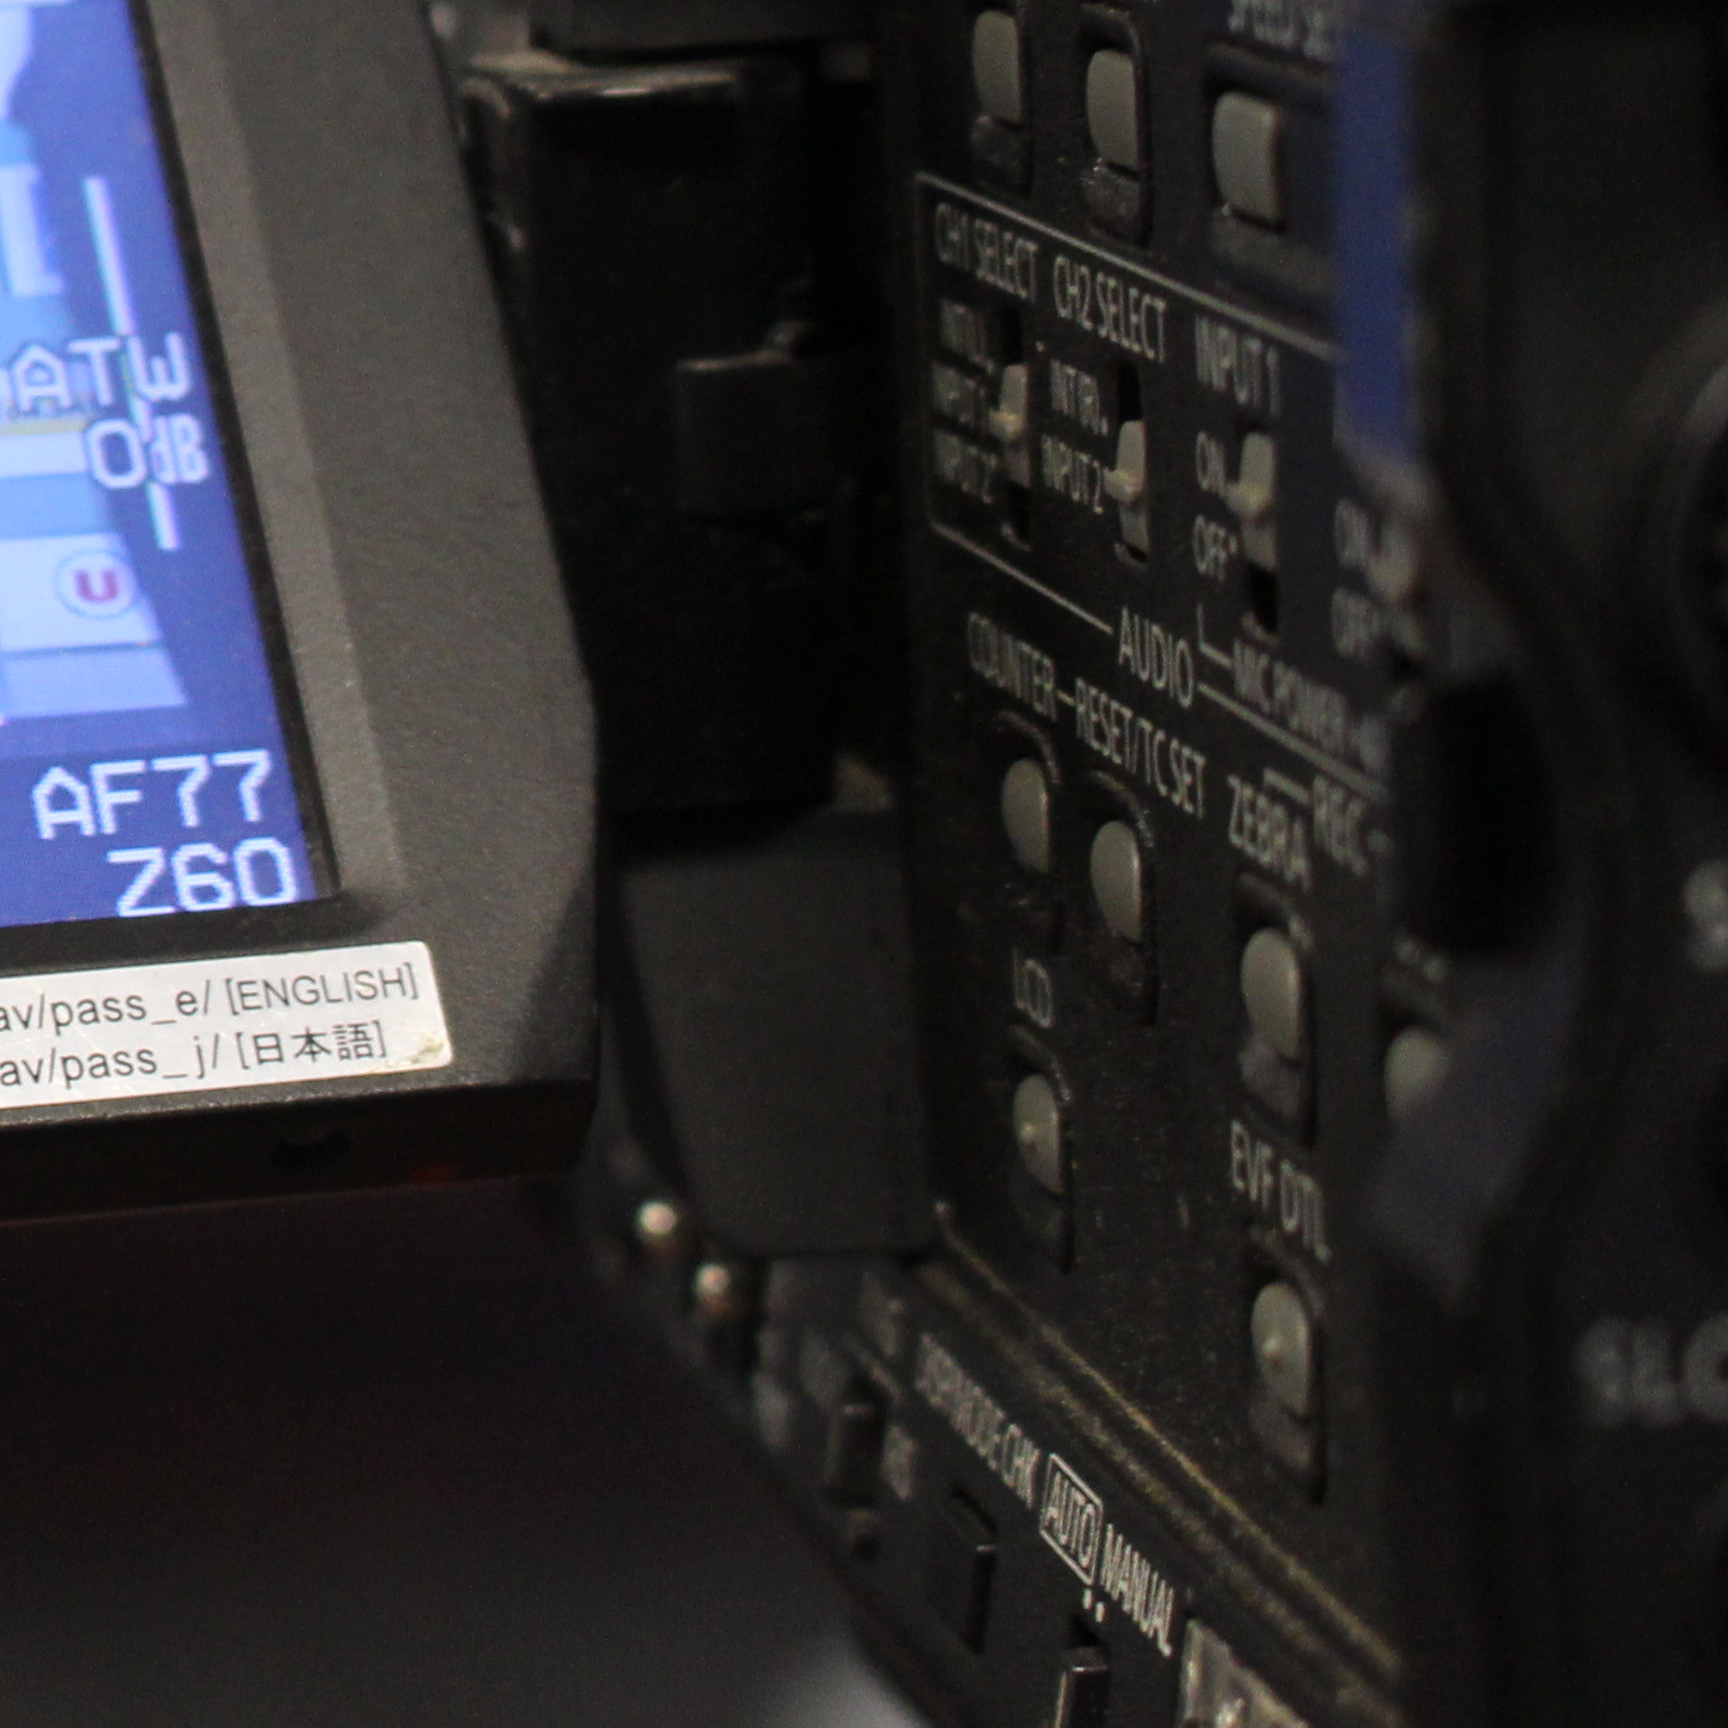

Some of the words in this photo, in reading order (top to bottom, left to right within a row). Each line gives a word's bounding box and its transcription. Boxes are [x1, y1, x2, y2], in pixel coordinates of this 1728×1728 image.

[974, 219, 1038, 303] SELECT
[1053, 254, 1094, 330] CH2
[1097, 272, 1167, 364] SELECT
[8, 330, 192, 414] ATW
[1195, 316, 1263, 409] INPUT
[967, 612, 1058, 722] COUNTER
[1119, 606, 1195, 708] AUDIO
[30, 748, 275, 841] AF77
[1227, 774, 1312, 893] ZEBRA
[104, 836, 297, 919] Z60
[226, 962, 420, 1016] [ENGLISH]
[1013, 948, 1054, 1029] LCD
[235, 1020, 388, 1071] [日本語]
[1230, 1120, 1280, 1212] EVF
[1278, 1158, 1332, 1264] DTL
[1044, 1470, 1097, 1570] AUTO
[1100, 1522, 1175, 1658] MANUAL
